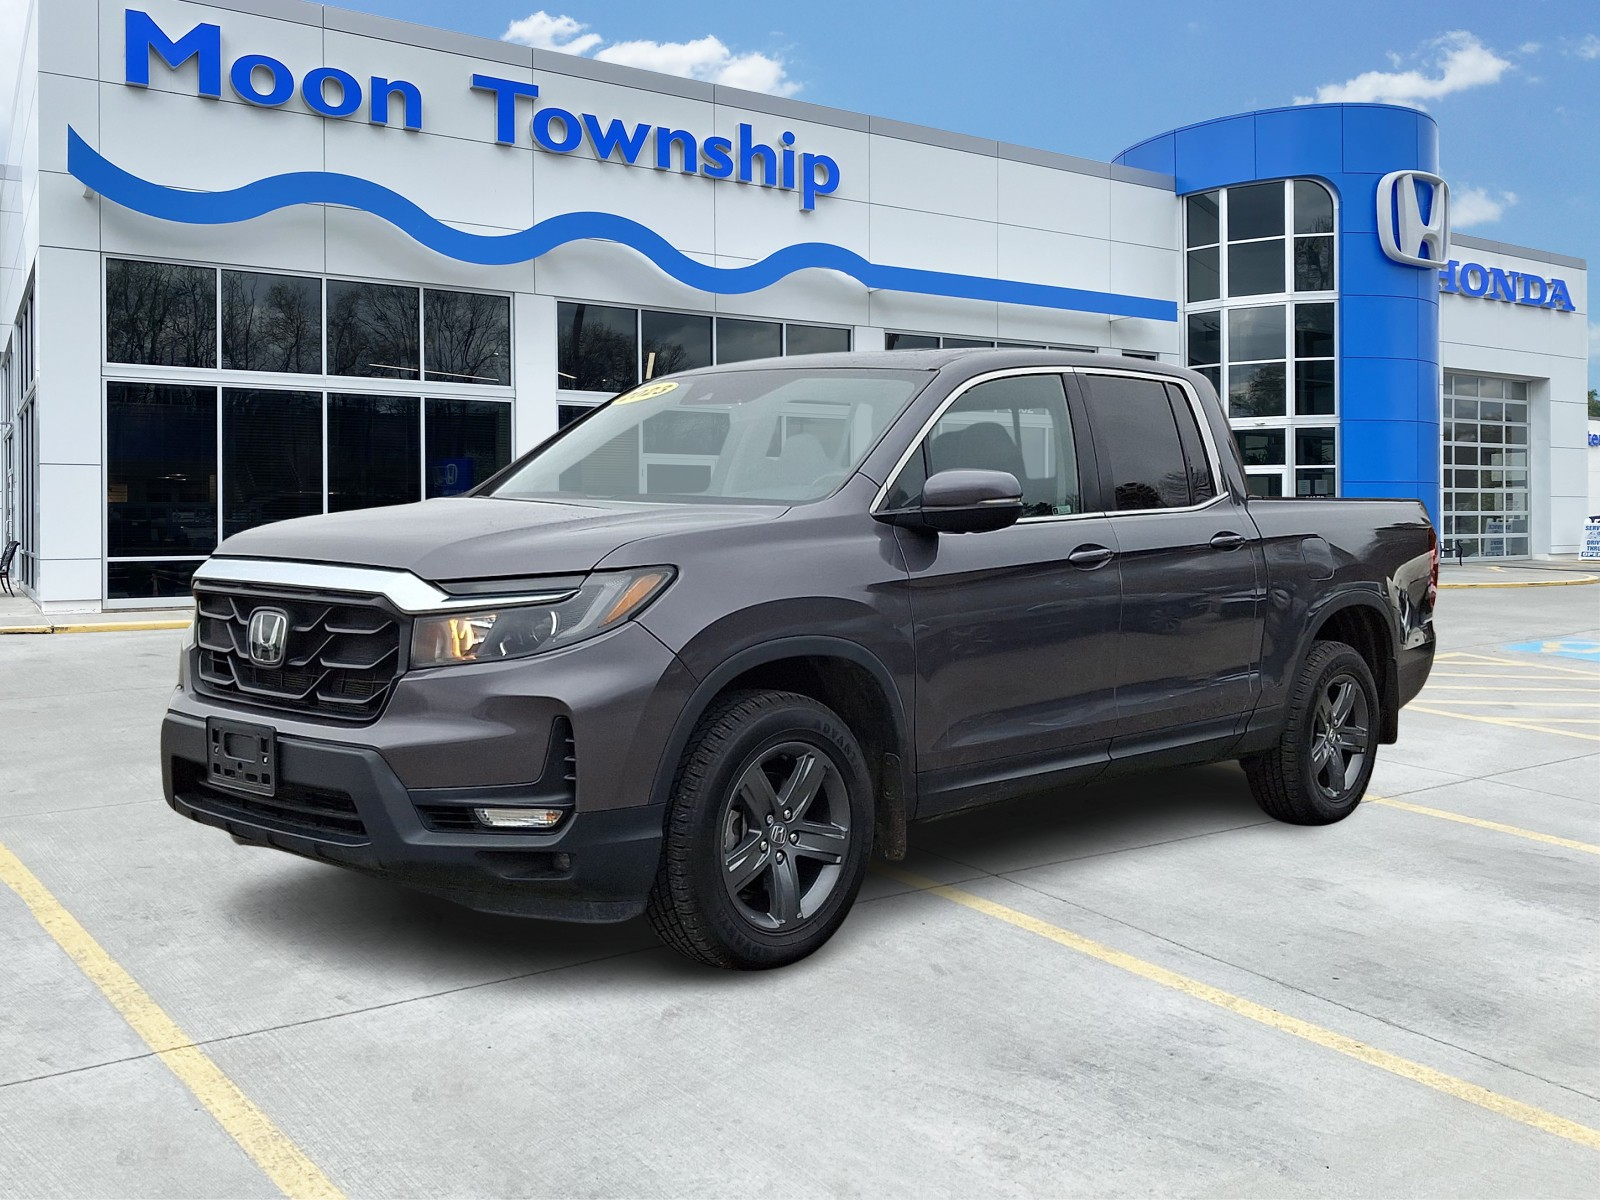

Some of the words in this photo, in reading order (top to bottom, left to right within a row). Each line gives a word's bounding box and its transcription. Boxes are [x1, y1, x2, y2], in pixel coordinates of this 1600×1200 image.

[125, 9, 422, 131] Moon
[470, 73, 840, 212] Township
[1438, 259, 1576, 312] HONDA
